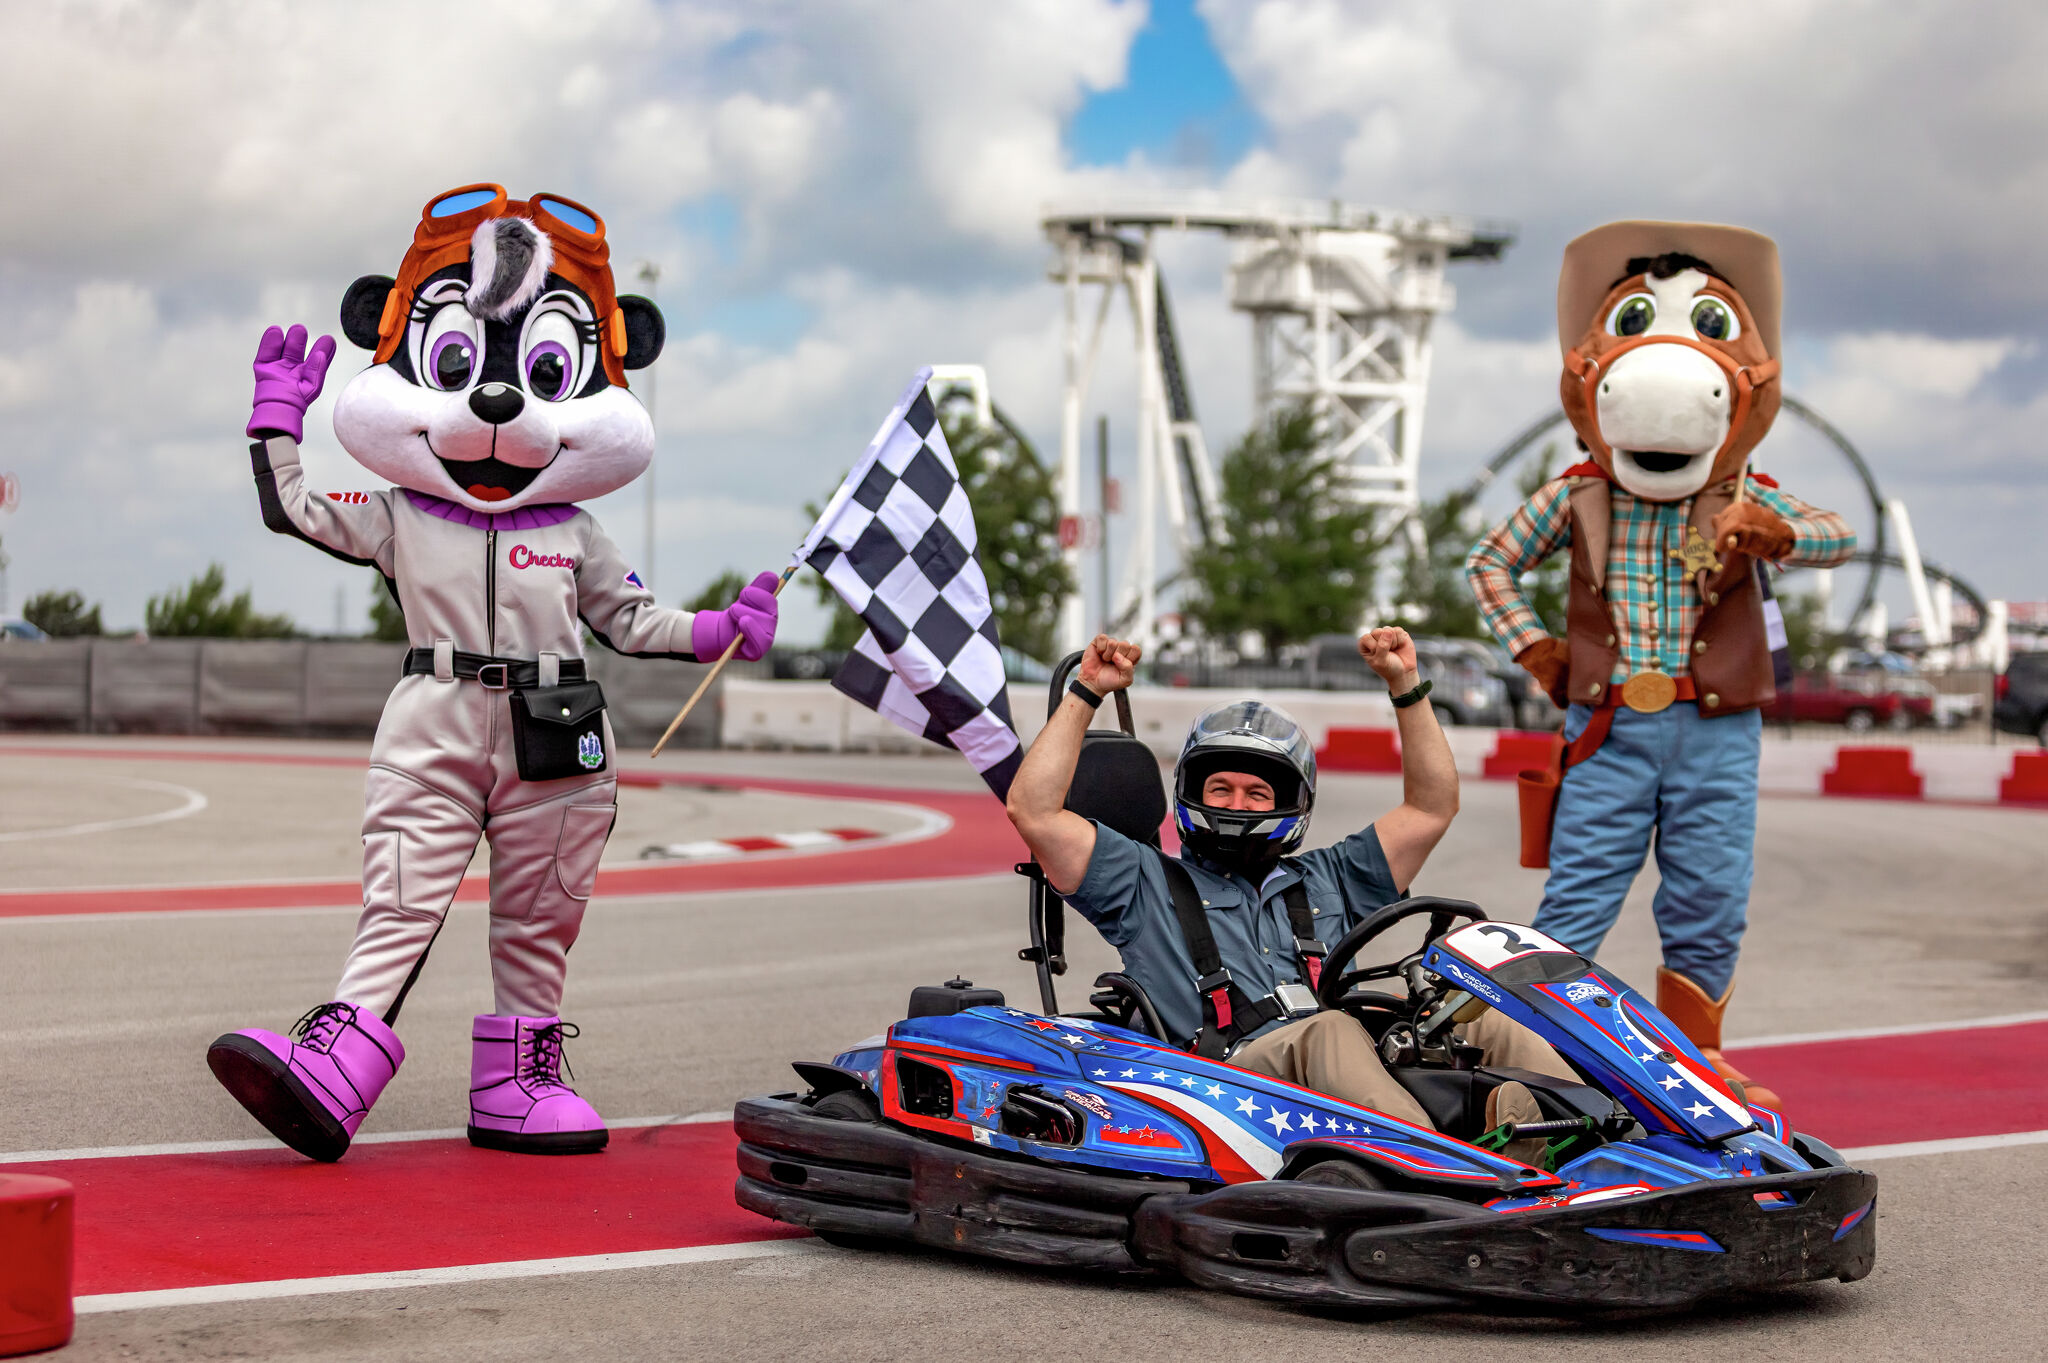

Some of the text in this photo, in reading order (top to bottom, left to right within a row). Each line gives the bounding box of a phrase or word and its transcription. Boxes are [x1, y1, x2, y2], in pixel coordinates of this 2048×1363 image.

[1477, 925, 1541, 954] 2
[1463, 972, 1492, 991] CIRCUIT
[1463, 979, 1501, 1003] AMERICAS
